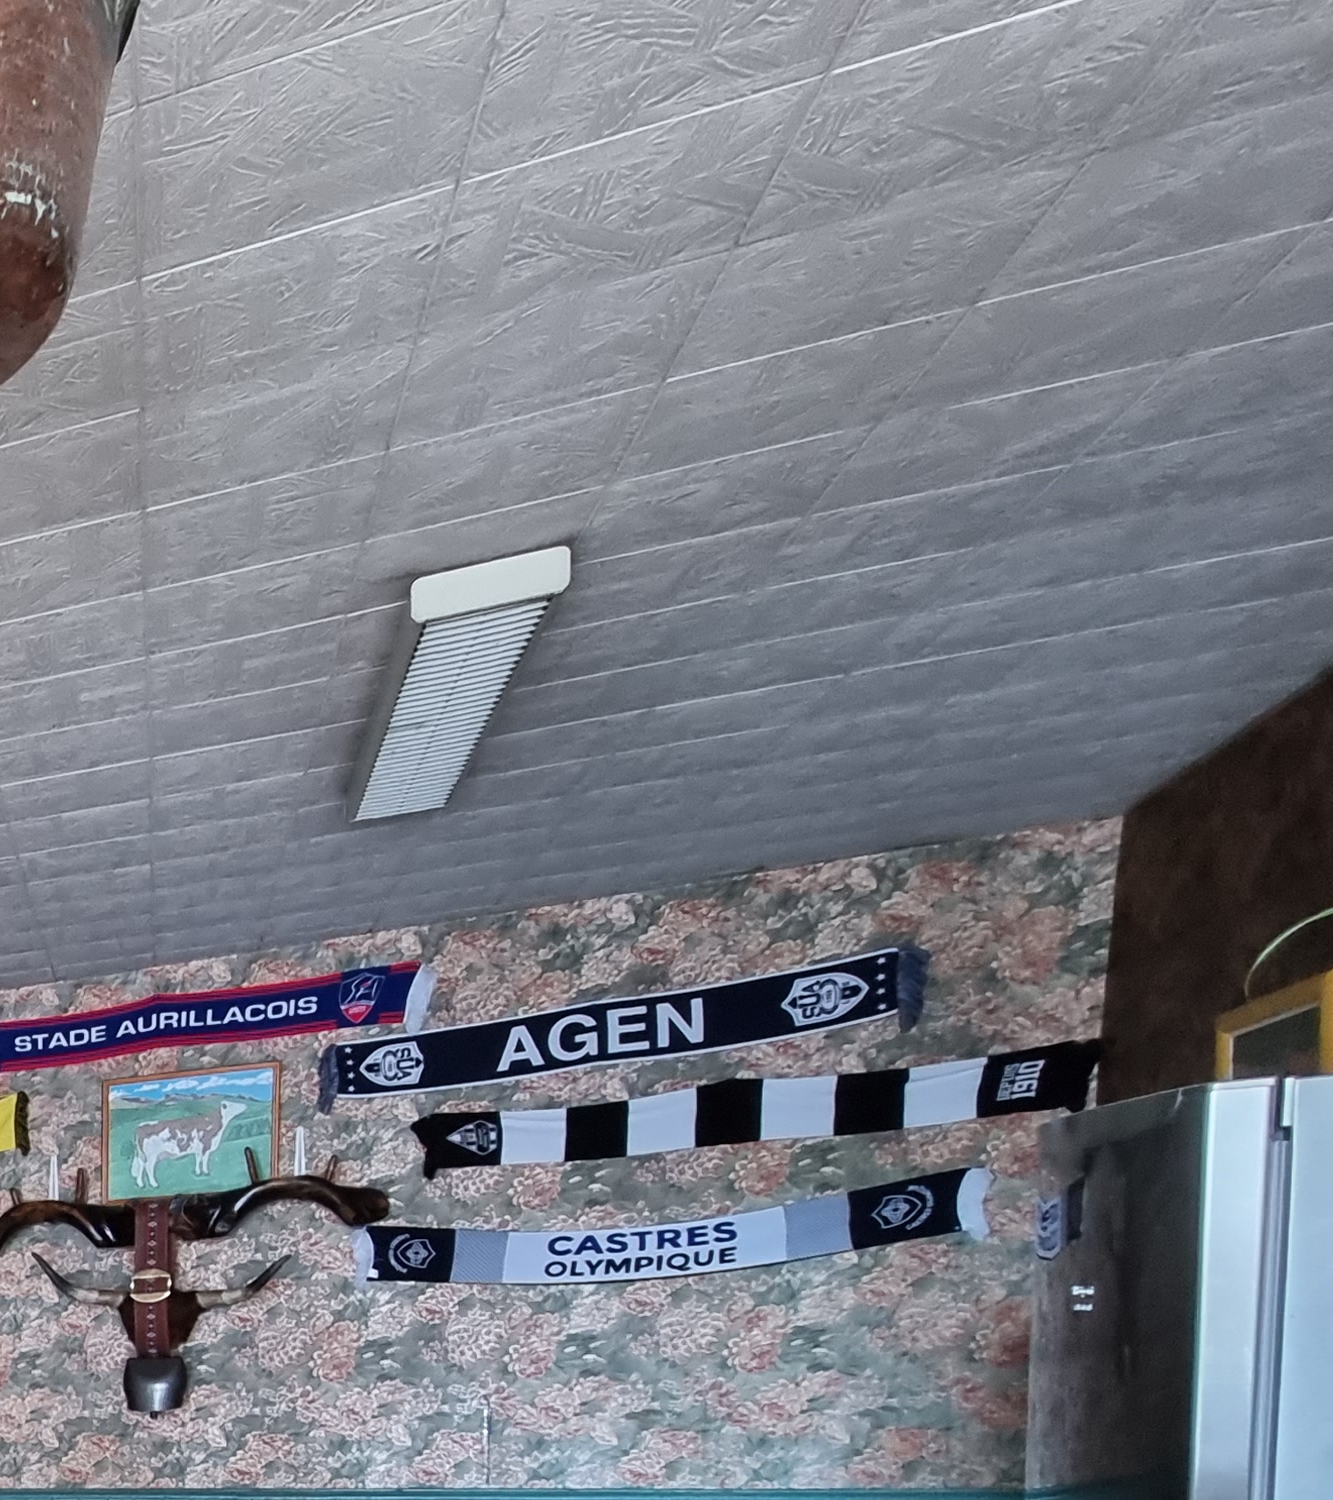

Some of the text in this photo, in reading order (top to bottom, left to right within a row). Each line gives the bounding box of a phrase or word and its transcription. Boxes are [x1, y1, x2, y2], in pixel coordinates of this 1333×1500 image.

[14, 996, 318, 1053] STADE AURILLACOIS
[496, 998, 705, 1072] AGEN
[396, 1047, 415, 1081] SUA
[1010, 1059, 1046, 1099] 1910
[547, 1222, 737, 1257] CASTRES
[544, 1247, 737, 1277] OLYMPIQUE
